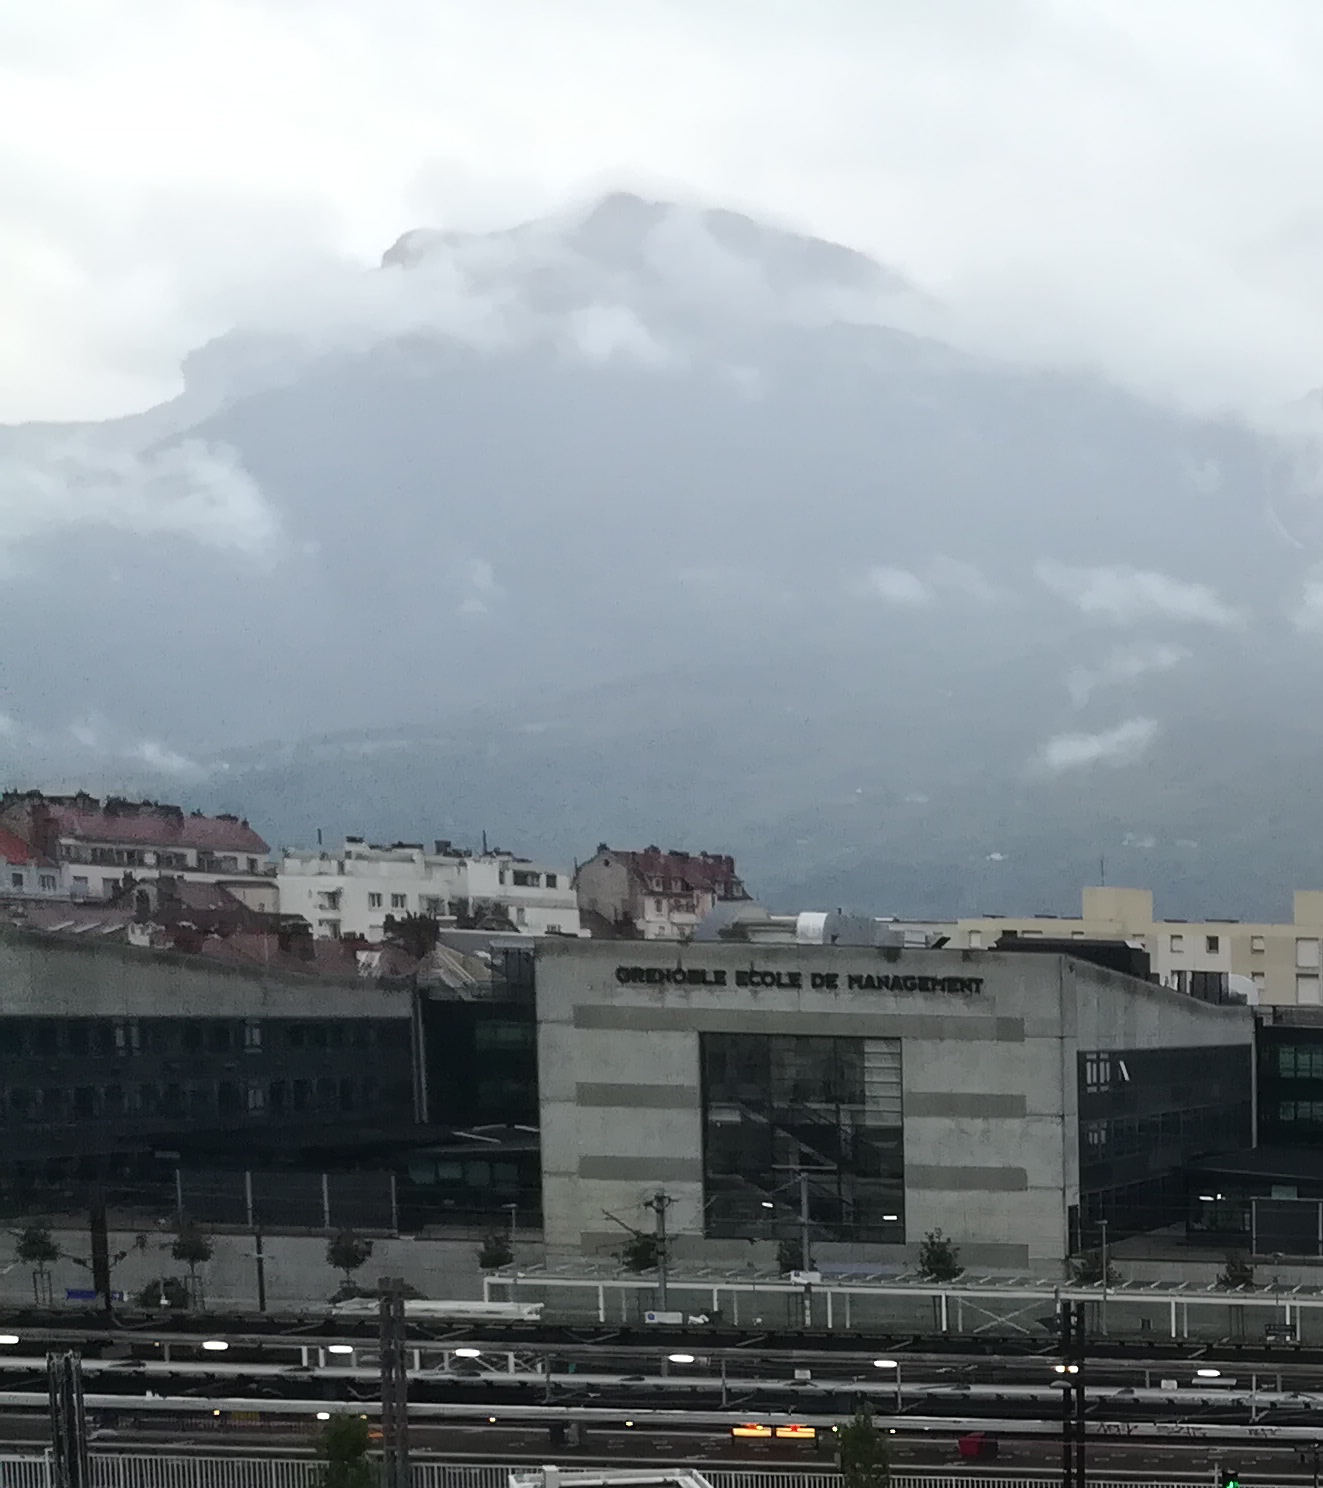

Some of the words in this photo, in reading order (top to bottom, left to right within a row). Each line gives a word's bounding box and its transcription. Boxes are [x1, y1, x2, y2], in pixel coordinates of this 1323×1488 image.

[615, 966, 727, 986] GRENOBLE
[811, 972, 839, 989] DE
[847, 974, 984, 994] MANAGEMENT
